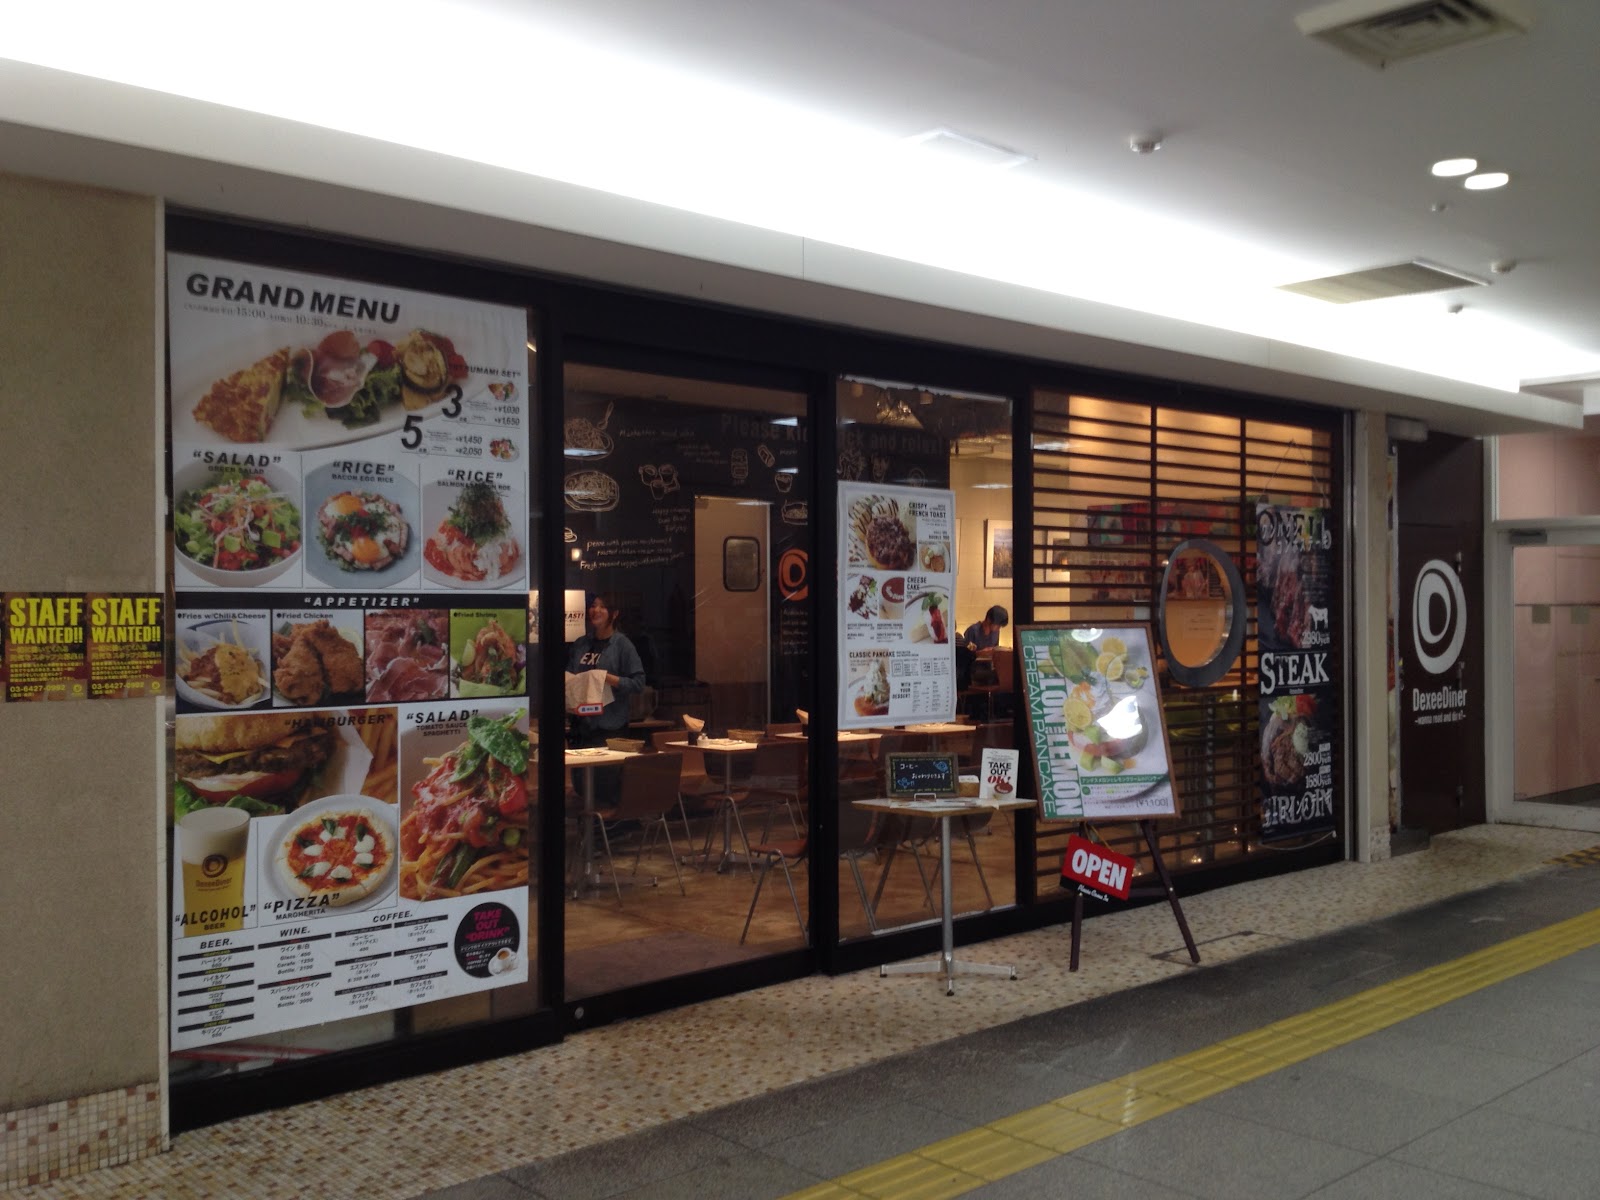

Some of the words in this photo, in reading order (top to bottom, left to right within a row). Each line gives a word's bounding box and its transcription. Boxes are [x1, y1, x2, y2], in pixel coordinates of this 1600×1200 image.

[186, 274, 305, 310] GRAND
[310, 291, 400, 324] MENU
[441, 384, 463, 419] 3
[401, 415, 423, 450] 5
[193, 450, 281, 468] “SALAD”
[333, 461, 395, 475] “RICE”
[448, 469, 503, 483] “RICE”
[908, 502, 928, 510] CRISPY
[907, 576, 927, 584] CHEESE
[304, 597, 419, 607] “APPETIZER”
[10, 597, 83, 627] STAFF
[91, 597, 161, 627] STAFF
[10, 627, 83, 644] WANTED!!
[91, 626, 161, 643] WANTED!!
[872, 650, 895, 658] PANCAKE
[1260, 652, 1330, 695] STEAK
[1034, 645, 1068, 722] MLON
[1412, 686, 1468, 712] DexeeDiner
[407, 708, 479, 724] “SALAD”
[416, 723, 444, 731] TOMATO
[423, 729, 461, 737] SPAGHETTI
[1023, 645, 1043, 714] CREAM
[1033, 719, 1056, 817] PANCAKE.
[988, 761, 1012, 770] TAKE
[990, 768, 1008, 776] OUT
[1047, 734, 1084, 816] LEMON
[1071, 848, 1127, 891] OPEN
[263, 893, 340, 913] “PIZZA”
[175, 903, 256, 927] “ALCOHOL”
[276, 908, 326, 921] MARGHERITA
[372, 910, 413, 923] COFFEE.
[474, 908, 502, 921] TAKE
[204, 922, 226, 931] BEER
[280, 926, 310, 938] WINE.
[475, 919, 499, 931] OUT
[200, 938, 233, 949] BEER.
